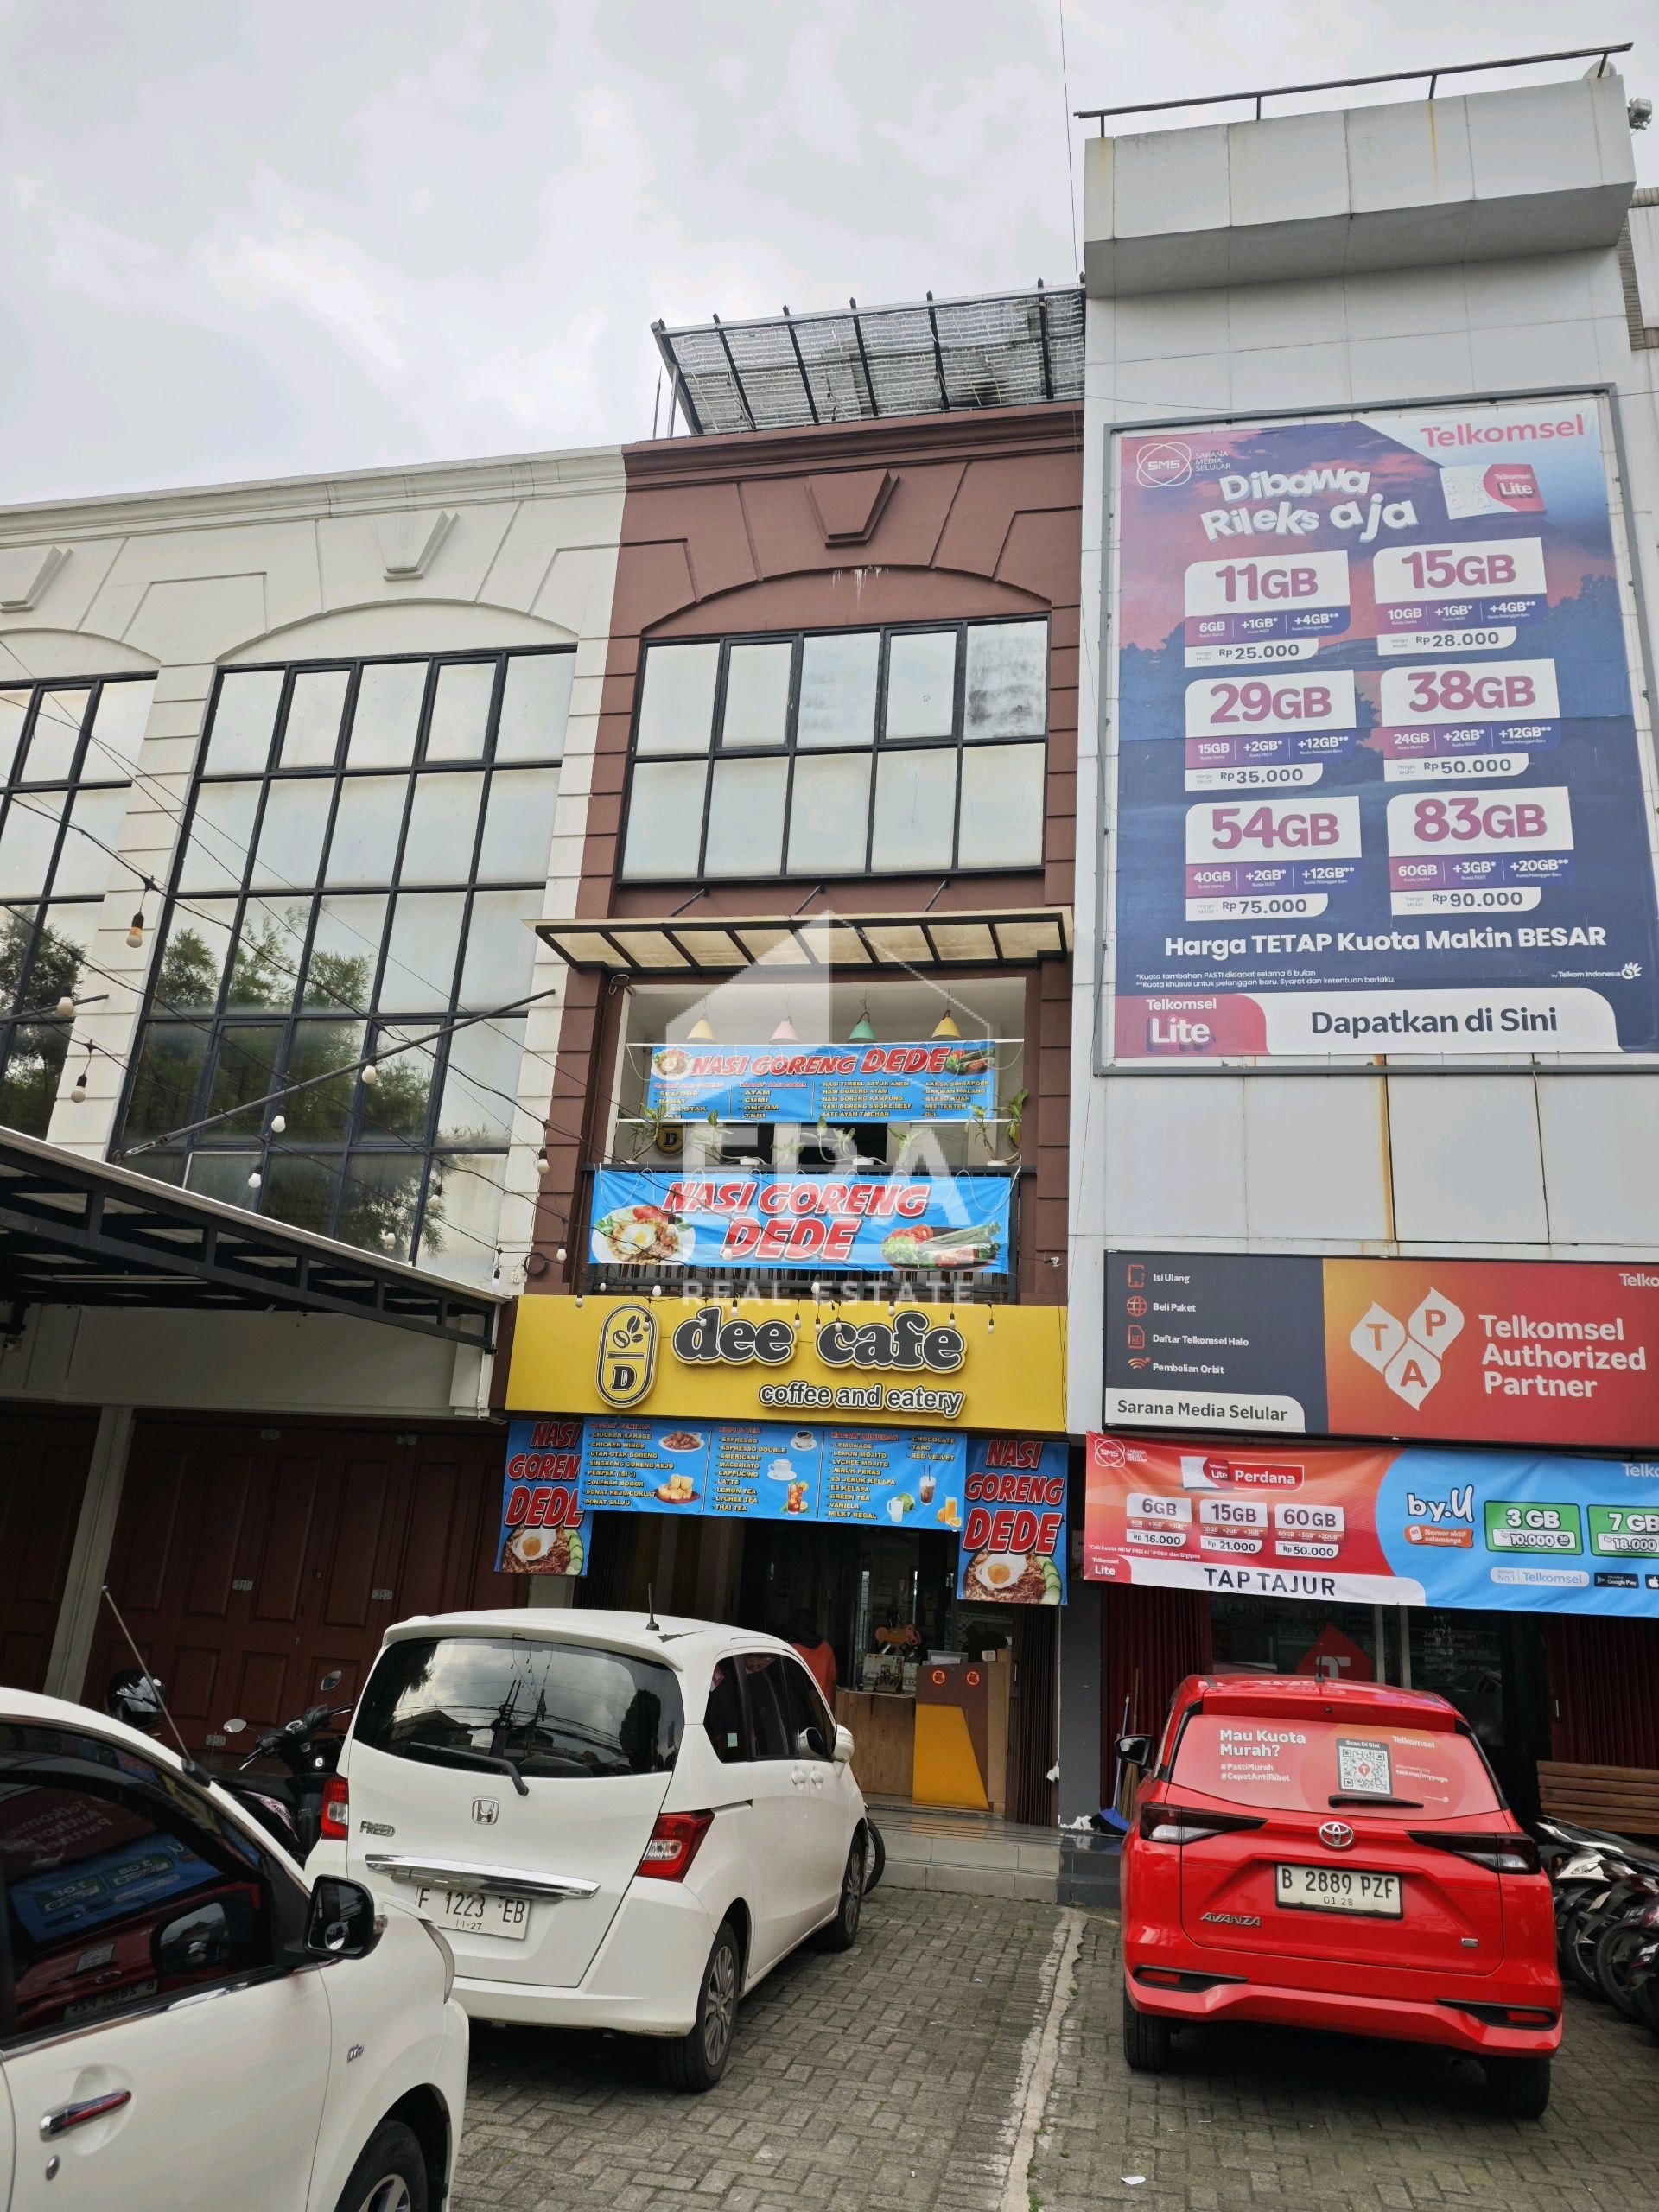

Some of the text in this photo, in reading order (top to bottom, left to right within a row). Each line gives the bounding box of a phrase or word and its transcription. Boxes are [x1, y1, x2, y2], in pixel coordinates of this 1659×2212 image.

[1421, 414, 1584, 448] Telkomsel
[1147, 460, 1180, 470] SMS
[1219, 468, 1370, 505] Dibawa
[1499, 482, 1534, 497] Lite
[1200, 493, 1419, 543] Rileks aja
[1402, 550, 1516, 589] 15GB
[1216, 563, 1319, 602] 11GB
[1199, 621, 1225, 632] 6GB
[1416, 636, 1430, 645] Rp
[1433, 632, 1499, 647] 28.000
[1219, 649, 1232, 658] Rp
[1235, 645, 1300, 659] 25.000
[1408, 670, 1535, 712] 38GB
[1210, 682, 1332, 723] 29GB
[1198, 743, 1230, 754] 15GB
[1220, 772, 1234, 781] Rp
[1237, 768, 1303, 784] 35.000
[1424, 762, 1438, 772] Rp
[1441, 759, 1511, 774] 50.000
[1212, 807, 1339, 849] 54GB
[1414, 797, 1547, 842] 83GB
[1398, 865, 1438, 876] 60GB
[1222, 901, 1236, 912] Rp
[1239, 899, 1307, 914] 75.000
[1432, 892, 1522, 906] Rp 90.000
[1166, 926, 1606, 961] Harga TETAP Kuota Makin BESAR
[1162, 971, 1203, 980] tambahan
[1225, 970, 1255, 979] didapat
[1216, 979, 1257, 988] pelanggan
[1146, 997, 1217, 1011] Telkomsel
[1151, 1014, 1210, 1044] Lite
[1312, 1007, 1558, 1039] Dapatkan di Sini
[690, 1047, 952, 1077] NASI GORENG DEDE
[661, 1181, 932, 1218] NASI GORENG
[720, 1217, 863, 1262] DEDE
[1154, 1273, 1190, 1284] Isi Ulang
[1153, 1303, 1196, 1313] Beli Paket
[1425, 1309, 1446, 1337] P
[1478, 1314, 1624, 1341] Telkomsel
[672, 1305, 965, 1370] dee cafe
[1153, 1334, 1249, 1346] Daftar Telkomsel Halo
[1366, 1324, 1389, 1351] T
[1482, 1343, 1646, 1371] Authorized
[610, 1364, 637, 1391] D
[1153, 1363, 1224, 1374] Pembelian Orbit
[1400, 1360, 1427, 1388] A
[1484, 1371, 1598, 1398] Partner
[760, 1381, 964, 1417] coffee and eatery
[1117, 1400, 1288, 1421] Sarana Media Selular
[530, 1421, 582, 1448] NASI
[986, 1440, 1043, 1468] NASI
[507, 1453, 582, 1480] GOREN
[1211, 1470, 1228, 1479] Lite
[1234, 1470, 1295, 1485] Perdana
[964, 1472, 1065, 1505] GORENG
[1142, 1498, 1177, 1516] 6GB
[1211, 1503, 1257, 1522] 15GB
[1284, 1509, 1336, 1527] 60GB
[1506, 1508, 1561, 1529] 3 GB
[1608, 1512, 1623, 1531] 7
[963, 1507, 1062, 1554] DEDE
[1145, 1535, 1180, 1545] 16.000
[1510, 1533, 1554, 1547] 10.000
[1207, 1540, 1255, 1552] Rp 21.000
[1294, 1547, 1333, 1556] 50.000
[1613, 1538, 1656, 1551] 18.000
[1095, 1565, 1115, 1575] Lite
[1522, 1572, 1582, 1584] Telkomsel
[1204, 1567, 1335, 1596] TAP TAJUR
[1220, 1729, 1306, 1744] Mau Kuota
[1392, 1735, 1435, 1749] Telkomsel
[1220, 1744, 1281, 1757] Murah?
[1221, 1763, 1274, 1771] #PastiMurah
[360, 1821, 396, 1837] FREED
[1282, 1868, 1395, 1898] B 2889 PZF
[418, 1888, 525, 1923] F 1223 EB
[1200, 1911, 1261, 1927] AVANZA
